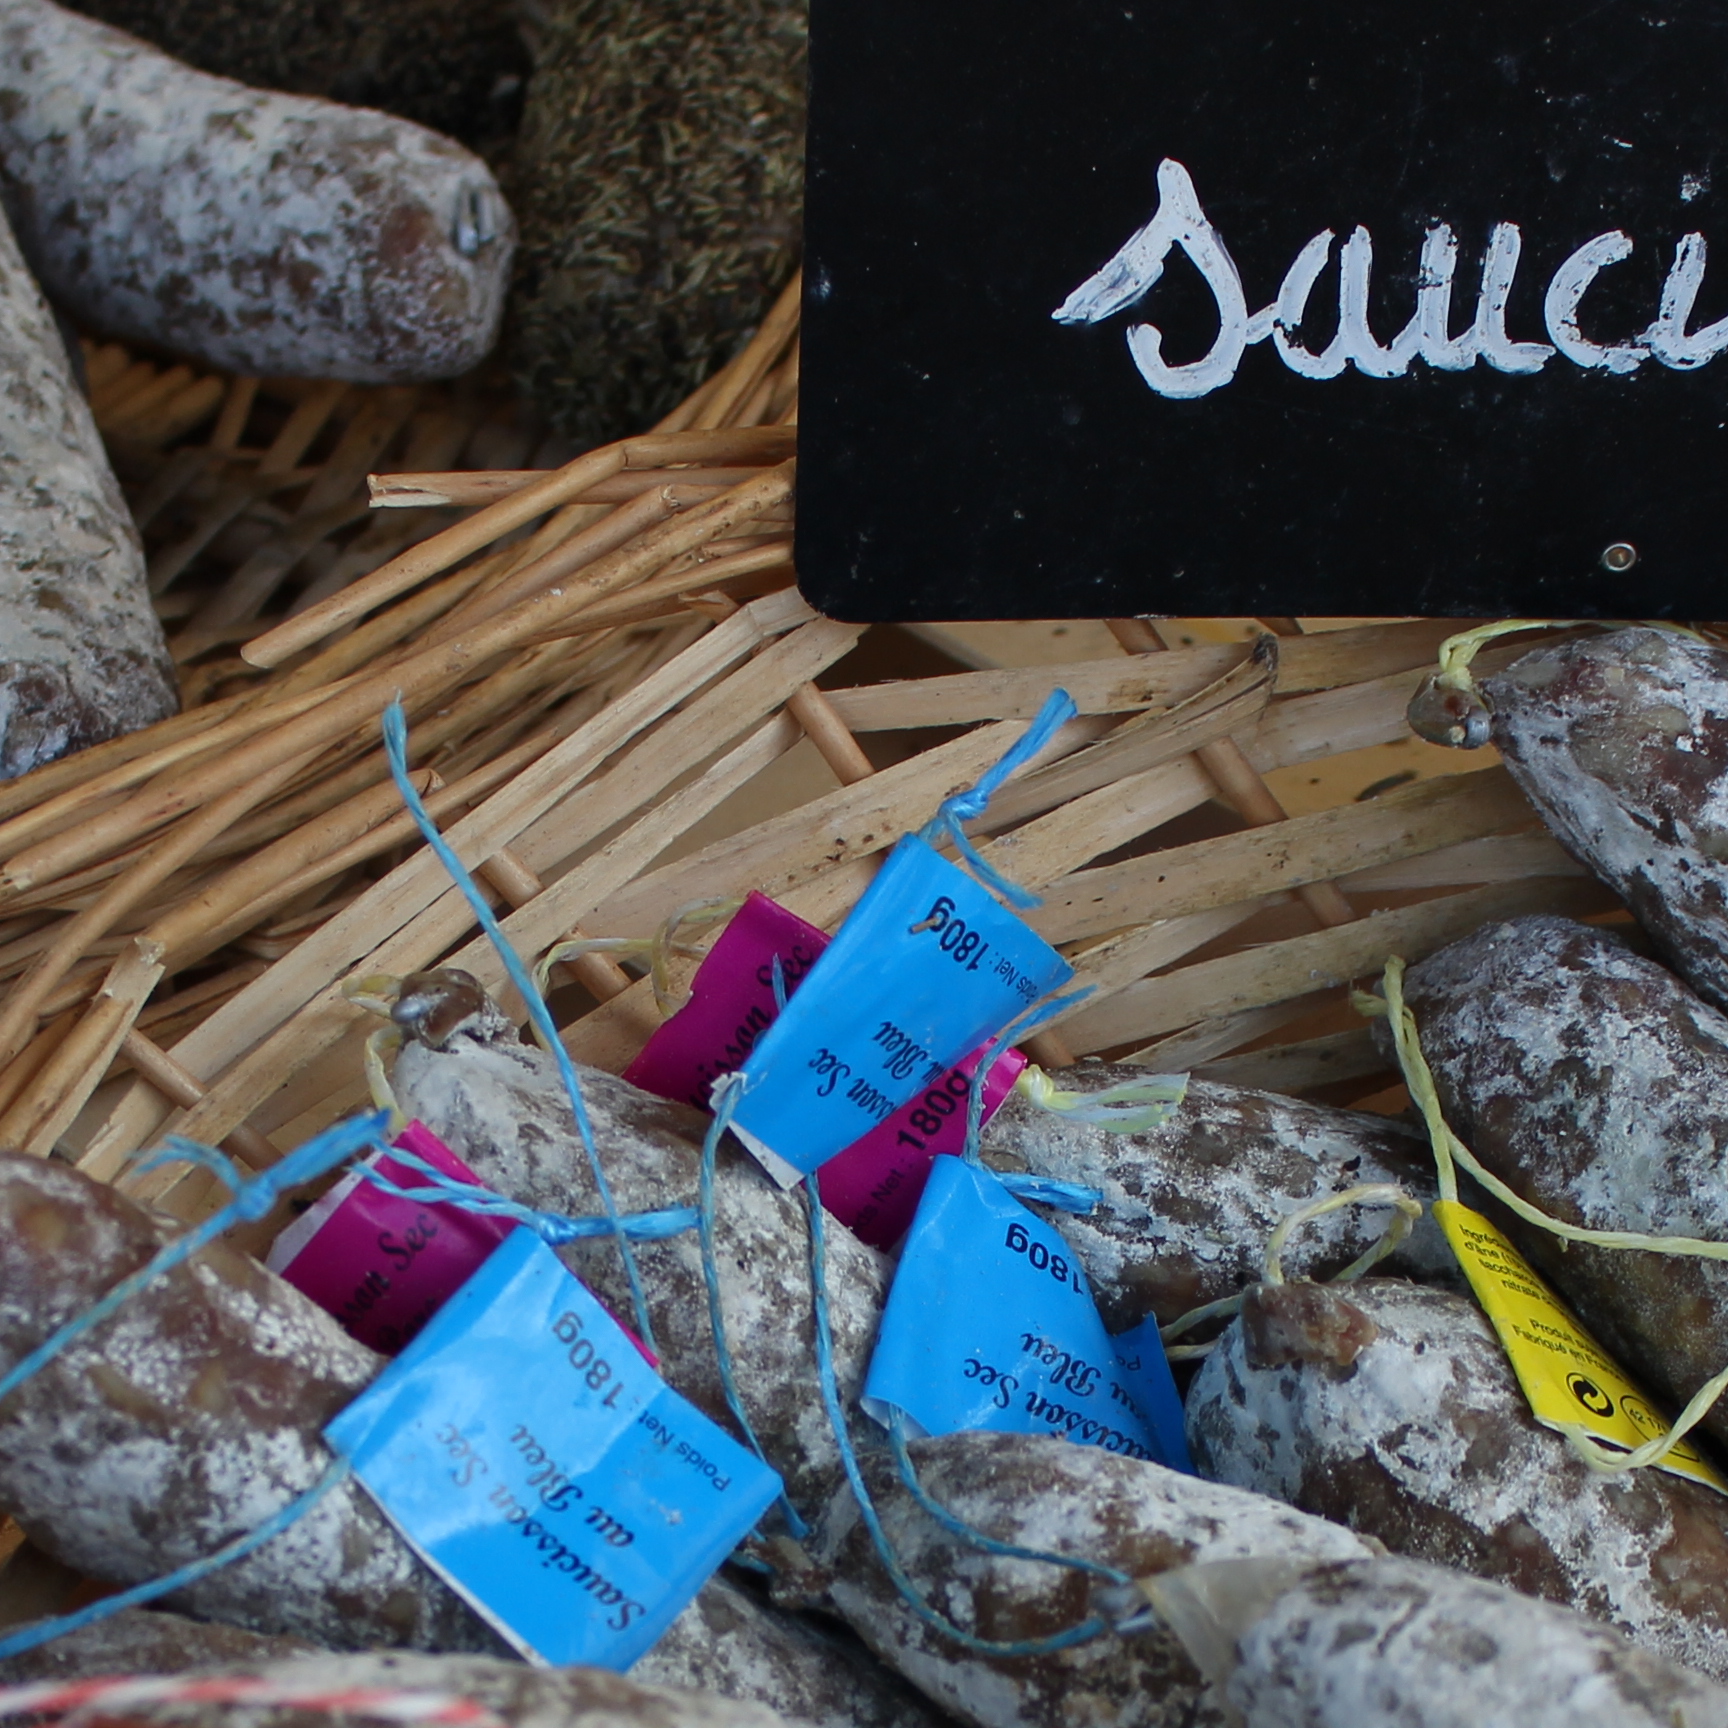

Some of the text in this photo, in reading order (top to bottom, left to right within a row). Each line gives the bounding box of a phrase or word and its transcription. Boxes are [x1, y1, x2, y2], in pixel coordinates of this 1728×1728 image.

[927, 896, 991, 972] 180g
[993, 956, 1021, 988] Net
[808, 1047, 851, 1098] Sec
[872, 1021, 928, 1081] Bleu
[377, 1213, 439, 1271] Sec
[1005, 1222, 1085, 1296] 180g
[551, 1310, 626, 1411] 180g
[963, 1358, 1020, 1410] Sec
[1021, 1333, 1102, 1397] Bleu
[638, 1409, 675, 1447] Net
[508, 1423, 635, 1548] au Bleu
[674, 1440, 733, 1492] Poids
[435, 1422, 646, 1631] Saucisson Sec
